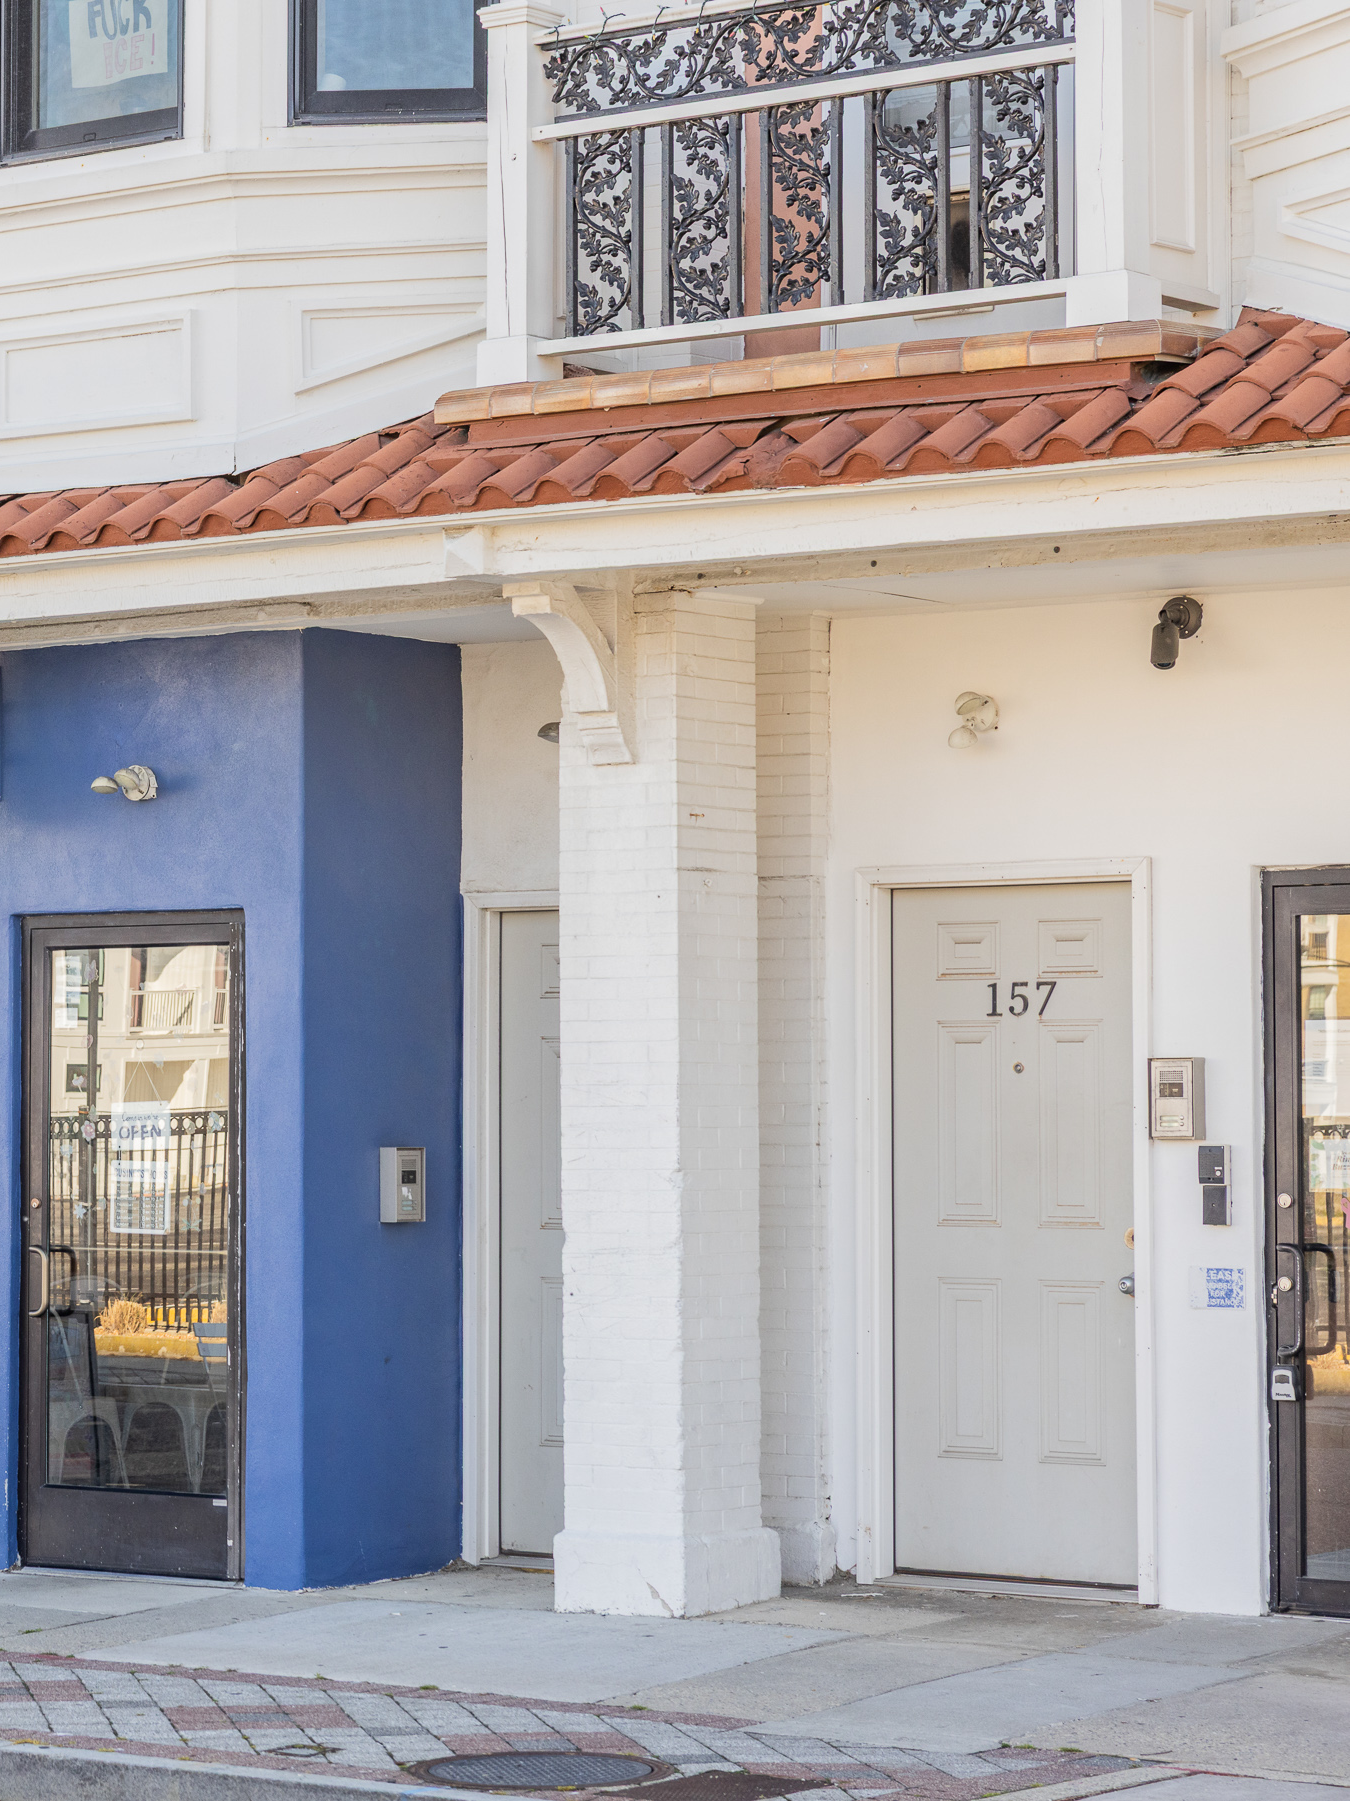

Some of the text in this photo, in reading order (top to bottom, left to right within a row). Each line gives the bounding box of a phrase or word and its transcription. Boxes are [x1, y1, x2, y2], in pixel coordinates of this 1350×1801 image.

[87, 0, 152, 40] FUCK
[986, 981, 1057, 1017] 157
[118, 1124, 162, 1141] OPEN
